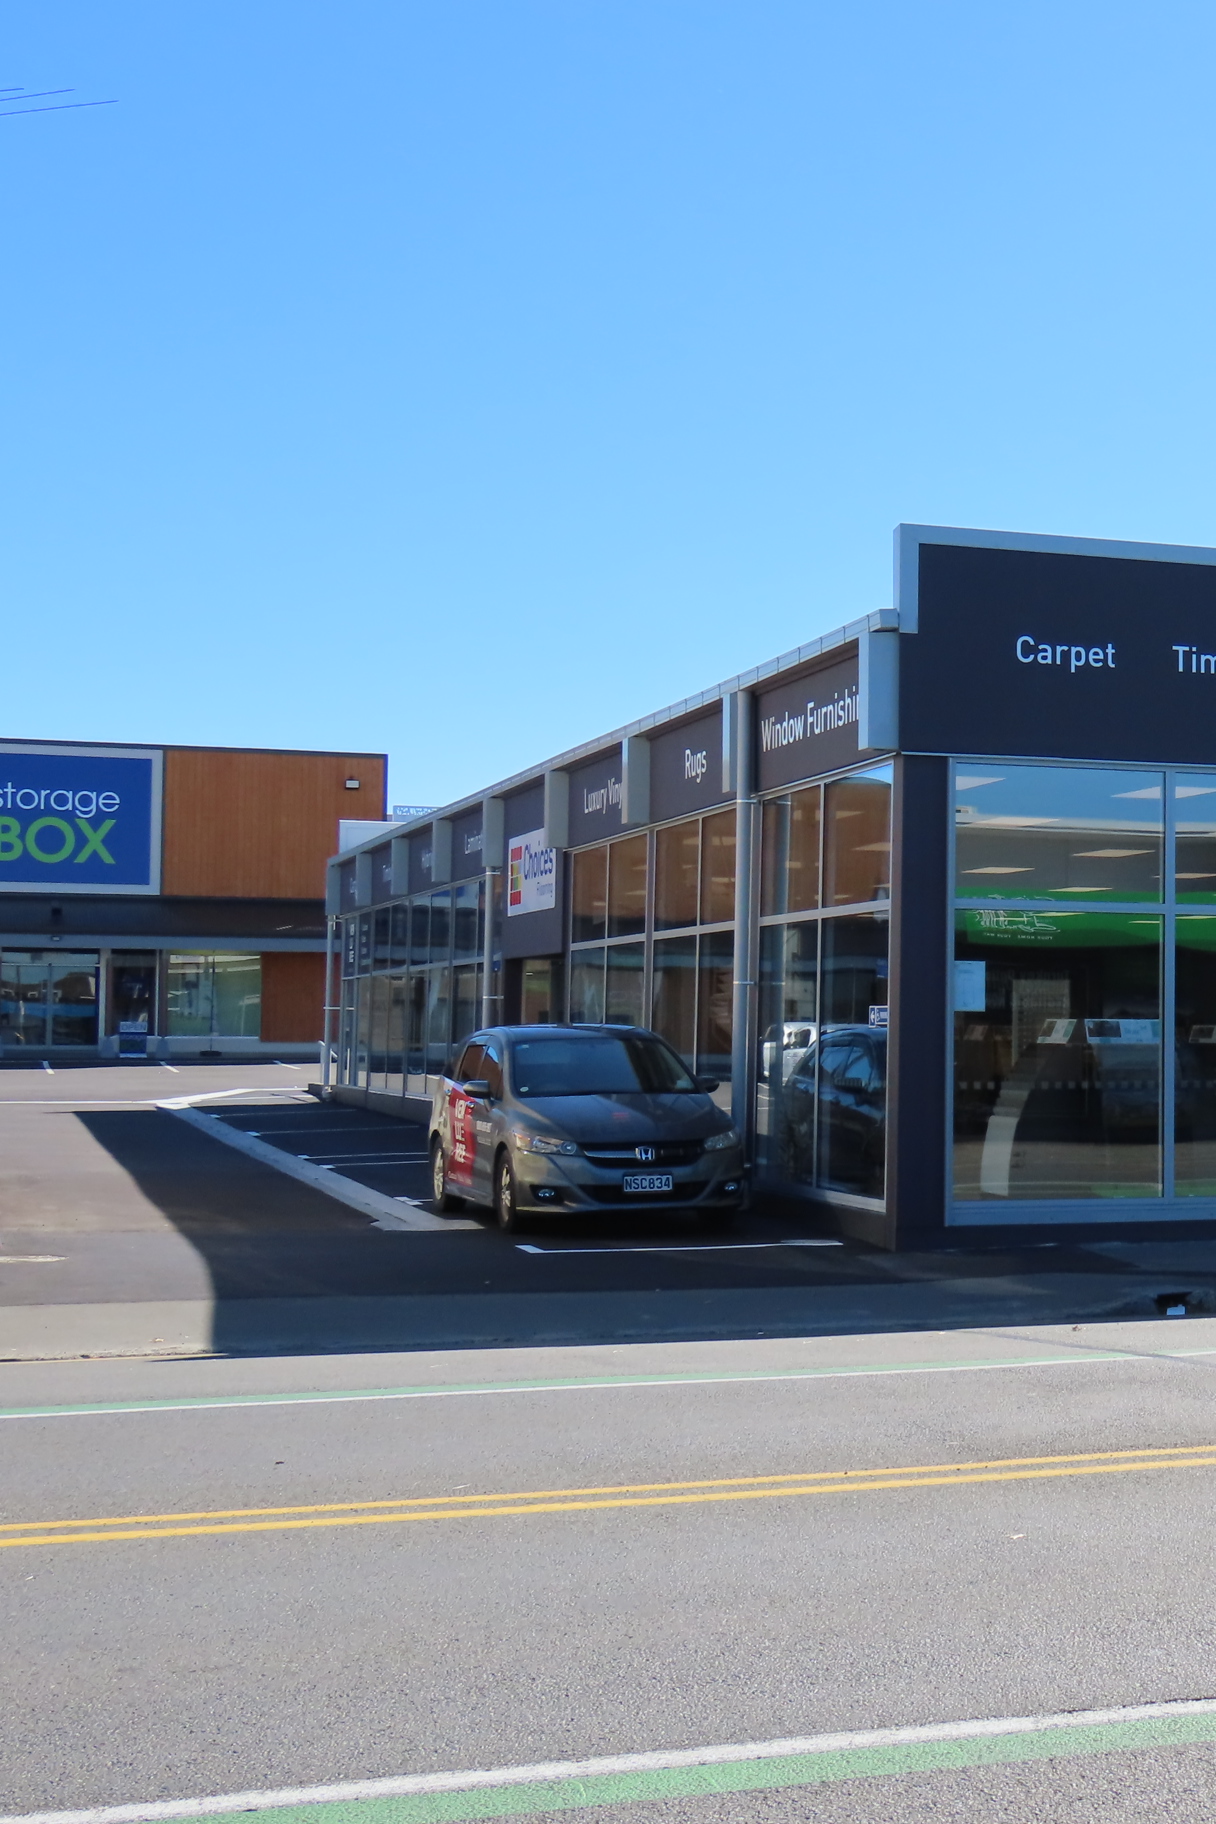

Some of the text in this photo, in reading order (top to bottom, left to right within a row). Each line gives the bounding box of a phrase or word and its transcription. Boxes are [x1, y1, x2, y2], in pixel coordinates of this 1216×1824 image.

[1015, 635, 1116, 673] Carpet
[761, 685, 859, 752] Window Furnishi
[685, 749, 707, 783] Rugs
[584, 777, 623, 815] Luxury Viny
[0, 815, 117, 865] BOX
[523, 840, 555, 880] Choices
[625, 1177, 671, 1190] NSC834
